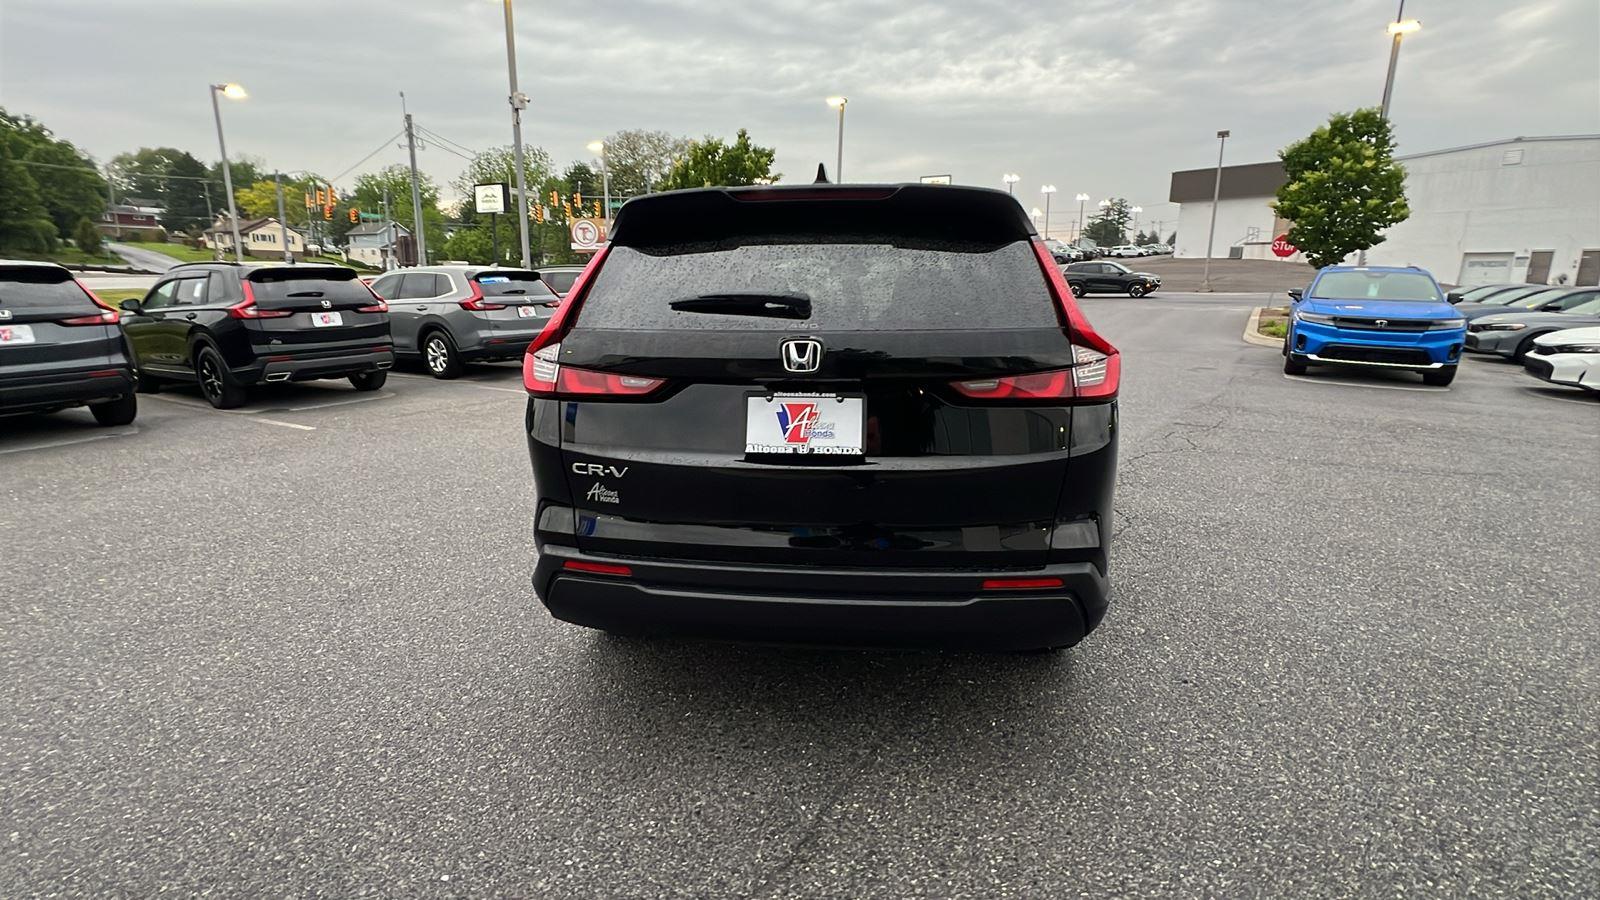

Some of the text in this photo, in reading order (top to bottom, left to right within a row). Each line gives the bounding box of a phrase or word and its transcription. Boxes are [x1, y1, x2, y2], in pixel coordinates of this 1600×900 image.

[803, 428, 834, 439] Honda
[745, 443, 794, 454] Altoona
[813, 446, 863, 455] HONDA
[572, 462, 629, 478] CR-V
